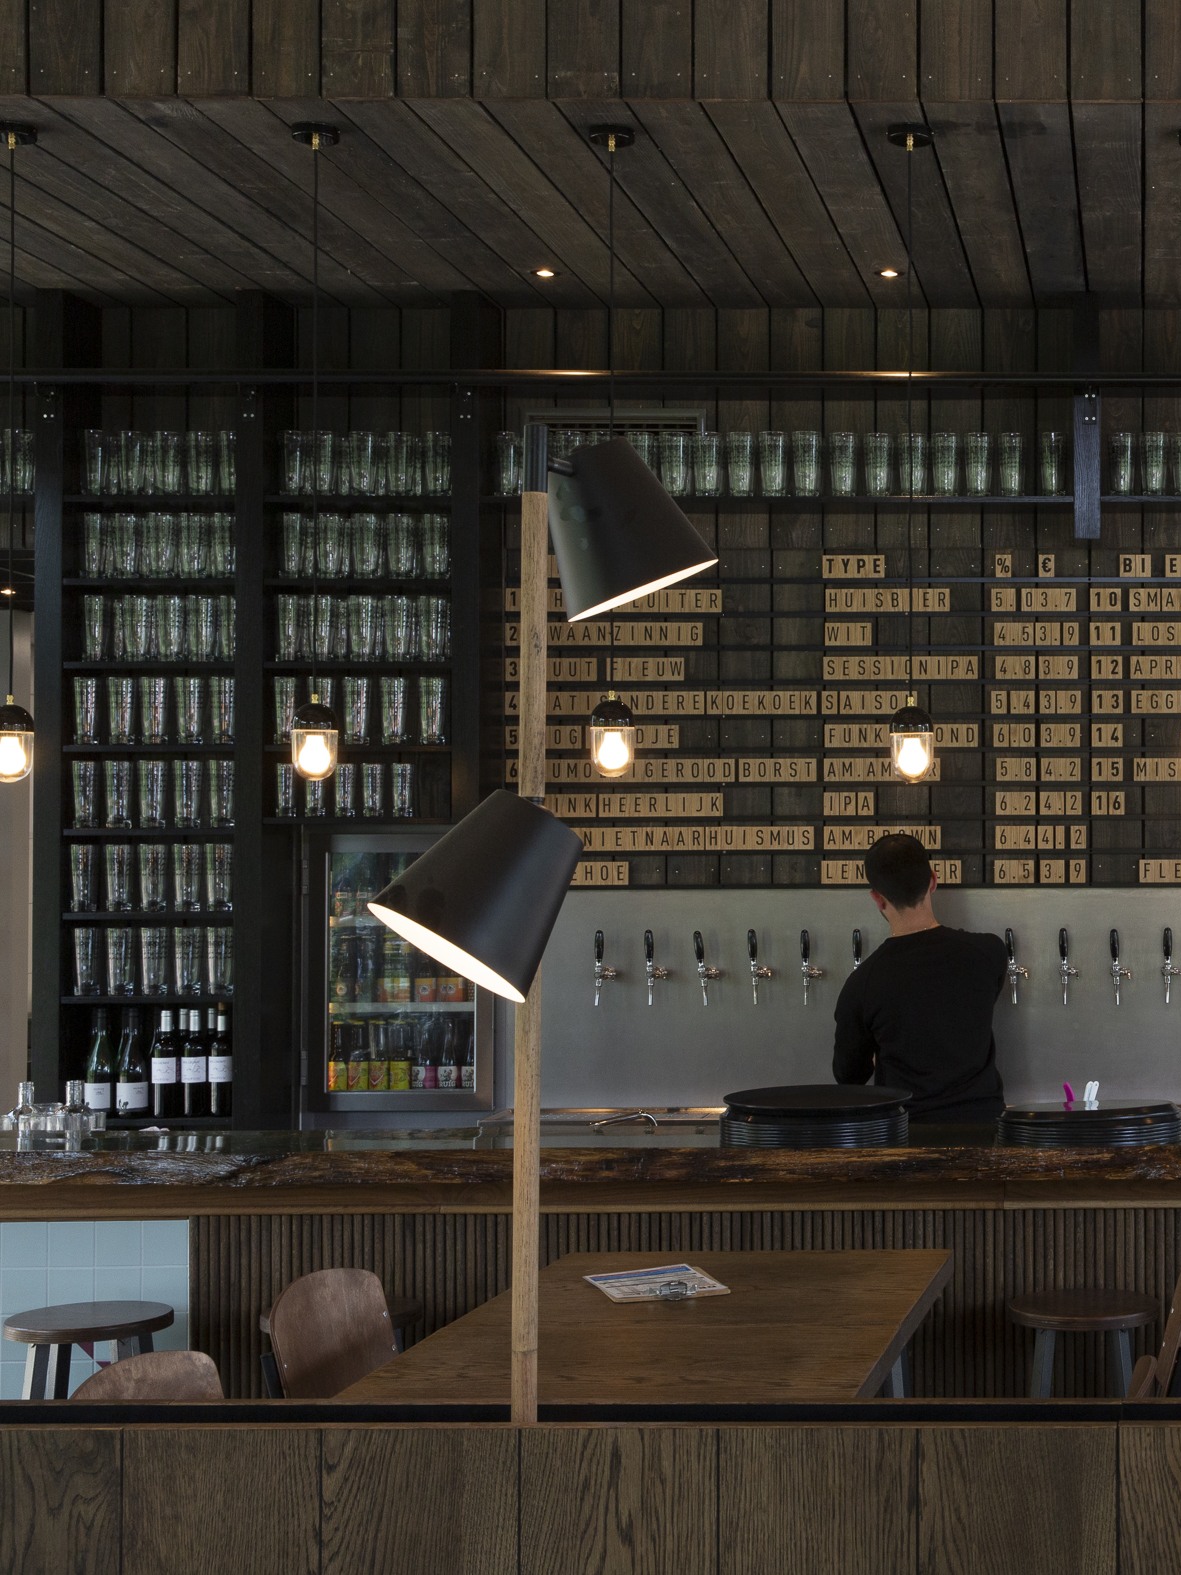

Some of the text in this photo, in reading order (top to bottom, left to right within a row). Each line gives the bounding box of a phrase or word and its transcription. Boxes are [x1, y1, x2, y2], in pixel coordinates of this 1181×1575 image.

[825, 557, 1052, 575] TYPE % €
[509, 591, 517, 606] 1
[828, 591, 947, 608] HUISBER
[1094, 591, 1118, 607] 10
[509, 625, 1075, 642] 2 WAANZINNIG WIT 4.5 3.9
[1094, 625, 1117, 641] 11
[509, 660, 518, 677] 3
[553, 661, 593, 677] UUT
[999, 659, 1032, 675] 4.8
[1043, 659, 1074, 675] 3.9
[1095, 659, 1119, 675] 12
[508, 694, 518, 711] 4
[825, 693, 911, 711] SAISO
[995, 693, 1031, 710] 5.4
[1043, 693, 1077, 710] 3.9
[1096, 693, 1120, 710] 13
[509, 729, 518, 745] 5
[554, 728, 578, 744] OG
[828, 726, 976, 743] FUNKOND
[997, 726, 1031, 743] 6.0
[1044, 726, 1076, 743] 3.9
[1096, 727, 1120, 743] 14
[509, 762, 518, 778] 6
[827, 761, 937, 778] AM.AMR
[1000, 760, 1032, 777] 5.8
[1045, 760, 1077, 777] 4.2
[1096, 760, 1120, 777] 15
[555, 794, 1078, 814] INK HEERLIJK IPA 6.2 4.2
[1096, 795, 1121, 811] 16
[572, 864, 625, 881] HOE
[998, 862, 1030, 880] 6.5
[1044, 862, 1082, 880] 3.9
